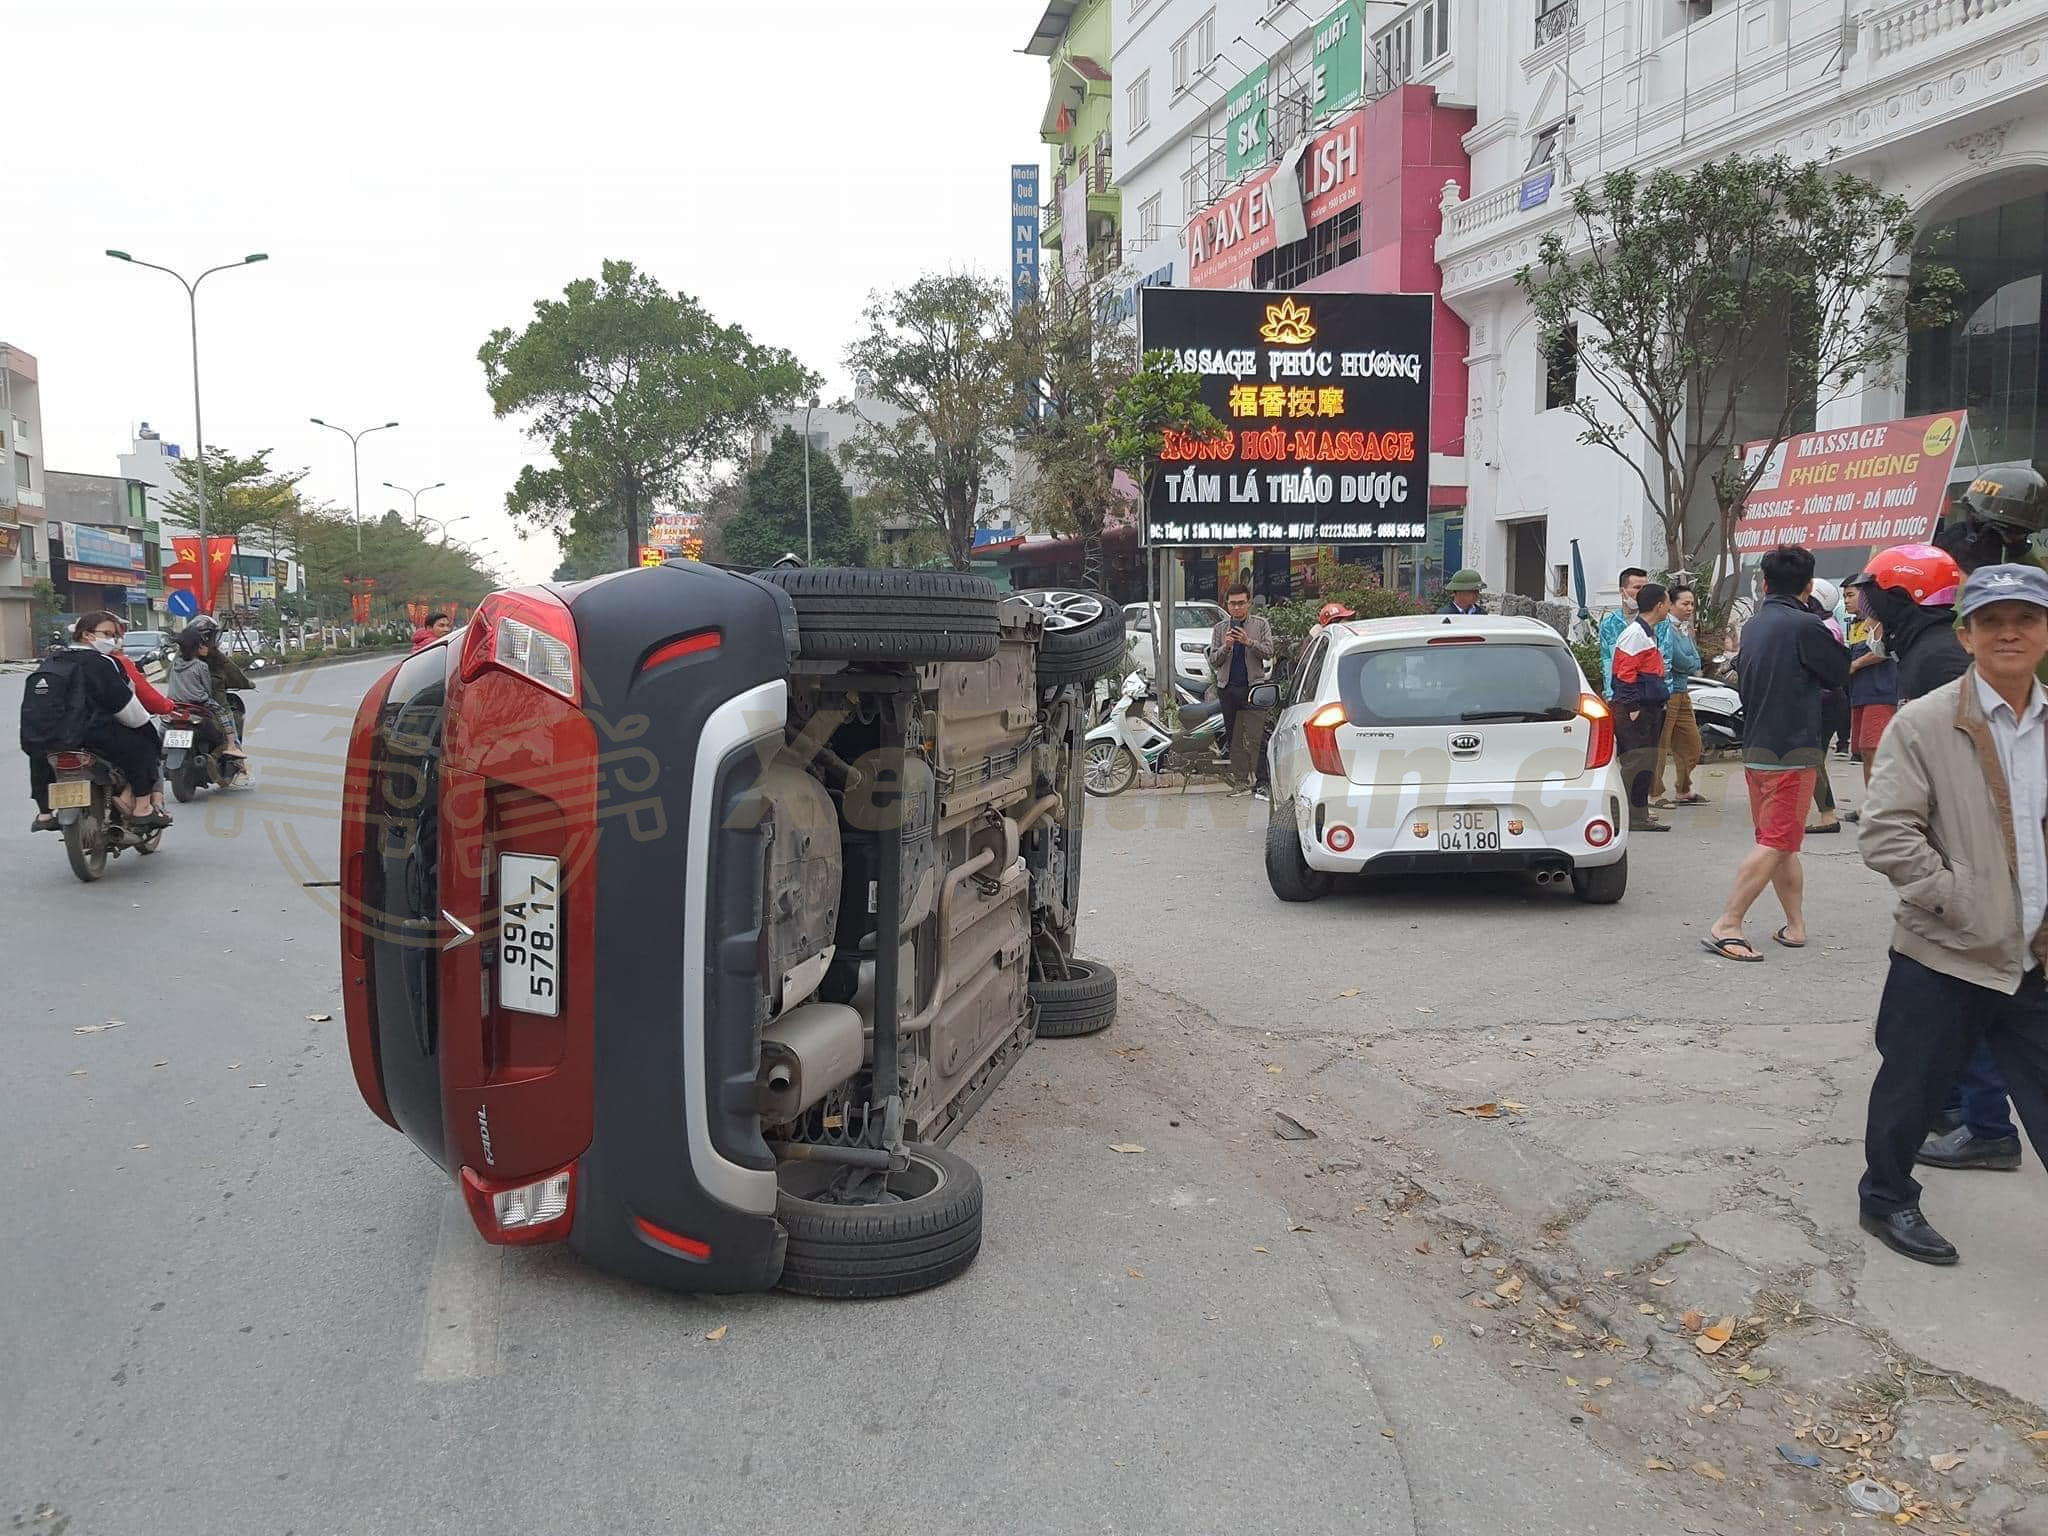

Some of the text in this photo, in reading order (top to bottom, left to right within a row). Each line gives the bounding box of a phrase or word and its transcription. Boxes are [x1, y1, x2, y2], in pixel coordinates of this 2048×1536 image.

[1012, 167, 1037, 180] Motel
[1249, 126, 1358, 234] ENLISH
[1017, 184, 1033, 199] Quê
[1269, 348, 1333, 381] PHÚC
[1341, 350, 1421, 383] HƯƠNG
[1229, 384, 1345, 417] 福香按摩
[1797, 427, 1888, 458] MASSAGE
[1939, 425, 1952, 446] 4
[1788, 453, 1920, 487] PHÚC HƯƠNG
[1229, 469, 1259, 503] LÁ
[1266, 466, 1332, 503] THẢO
[1341, 473, 1408, 508] DƯỢC
[1746, 481, 1919, 520] MASSAGE XÔNG HƠI ĐÁ MUỐI
[1762, 526, 1777, 546] ĐÁ
[1777, 525, 1807, 544] NÓNG
[1816, 519, 1841, 542] TẮM
[1842, 518, 1856, 540] LÁ
[1860, 514, 1891, 538] THẢO
[1892, 516, 1928, 541] DƯỢC
[1456, 737, 1476, 748] KIA
[1452, 812, 1484, 831] 30E
[1441, 832, 1498, 850] 041.80
[504, 903, 527, 966] 99A
[530, 874, 555, 998] 578.17
[477, 1104, 495, 1167] FADIL
